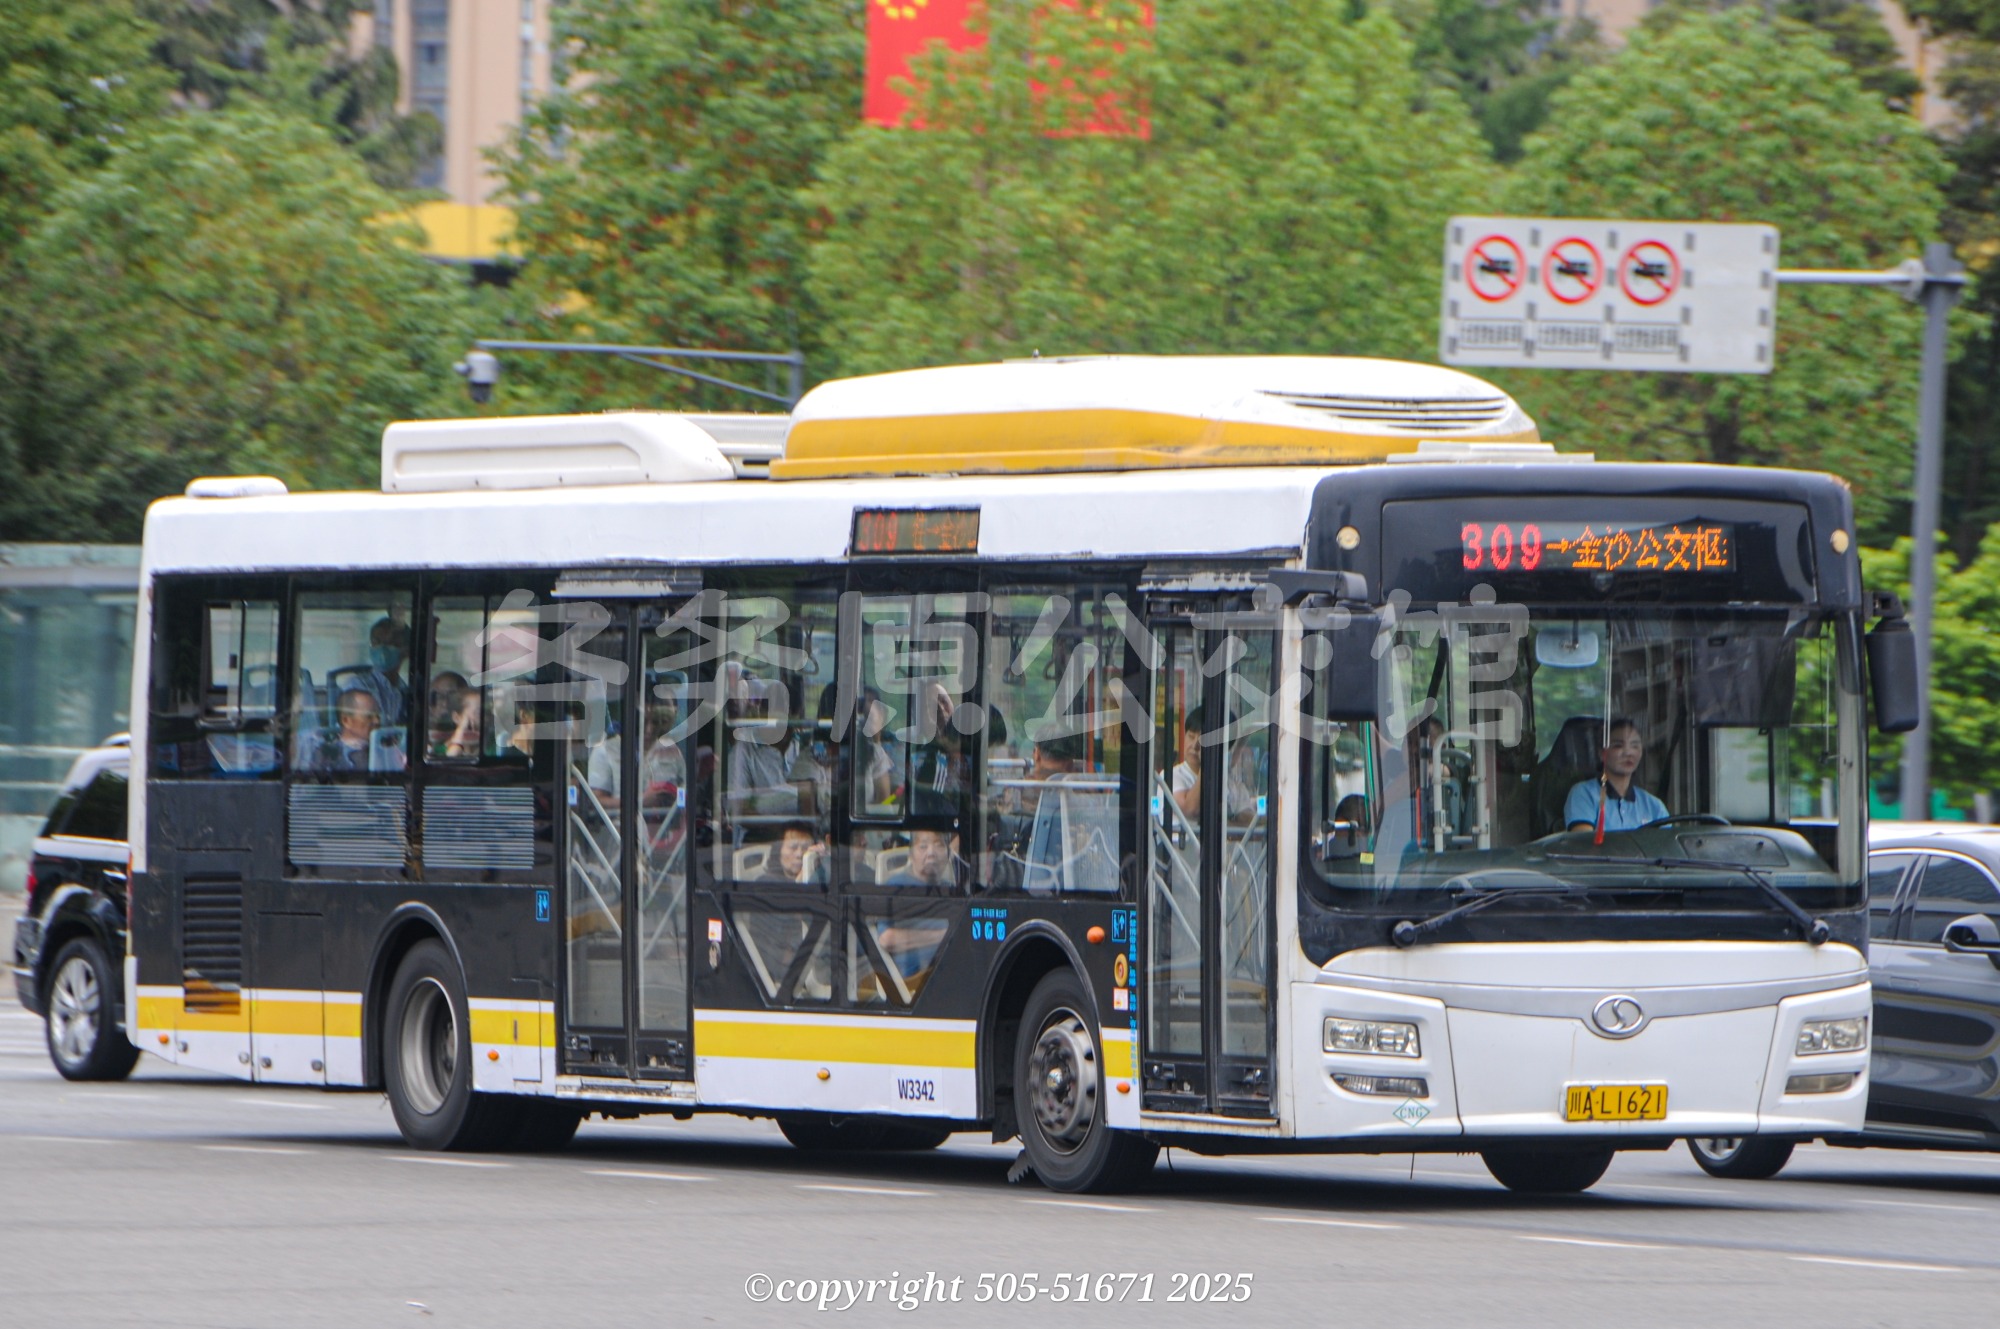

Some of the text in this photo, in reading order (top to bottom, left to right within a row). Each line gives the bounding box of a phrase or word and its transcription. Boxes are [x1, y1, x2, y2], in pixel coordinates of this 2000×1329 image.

[1461, 523, 1541, 570] 309
[897, 1078, 935, 1102] W3342
[1399, 1107, 1424, 1119] CNG
